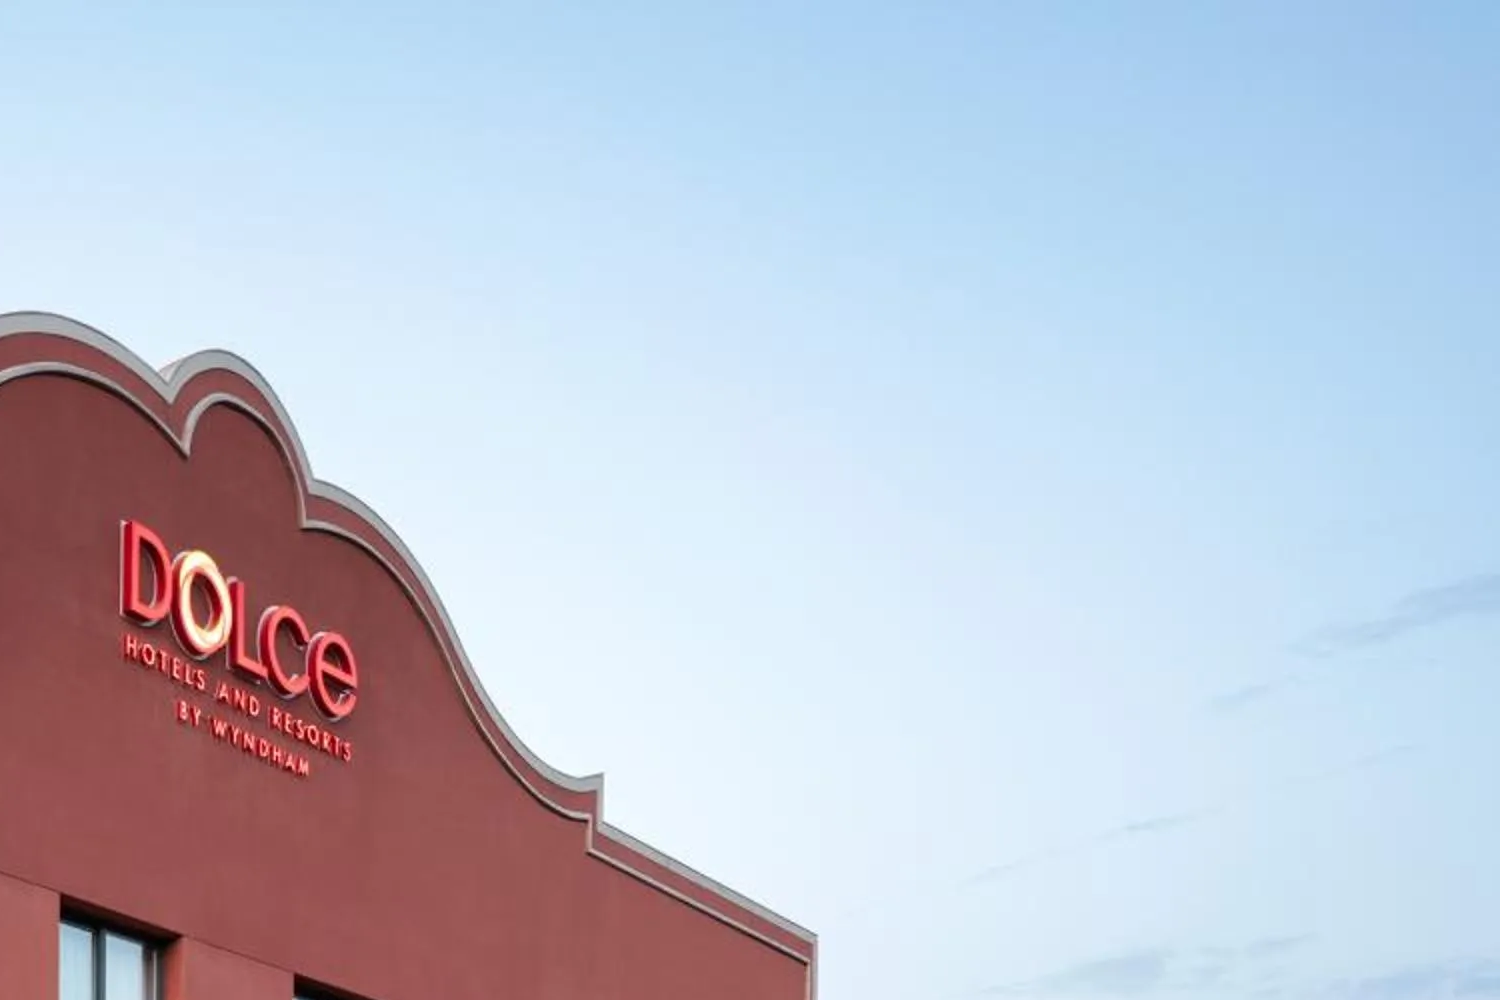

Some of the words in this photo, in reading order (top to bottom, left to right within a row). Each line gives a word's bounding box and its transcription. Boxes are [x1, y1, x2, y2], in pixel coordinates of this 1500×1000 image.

[122, 633, 206, 691] HOTELS
[215, 681, 261, 718] AND
[267, 706, 353, 762] RESORTS
[176, 700, 203, 727] BY
[208, 716, 310, 777] WYNDHAM
